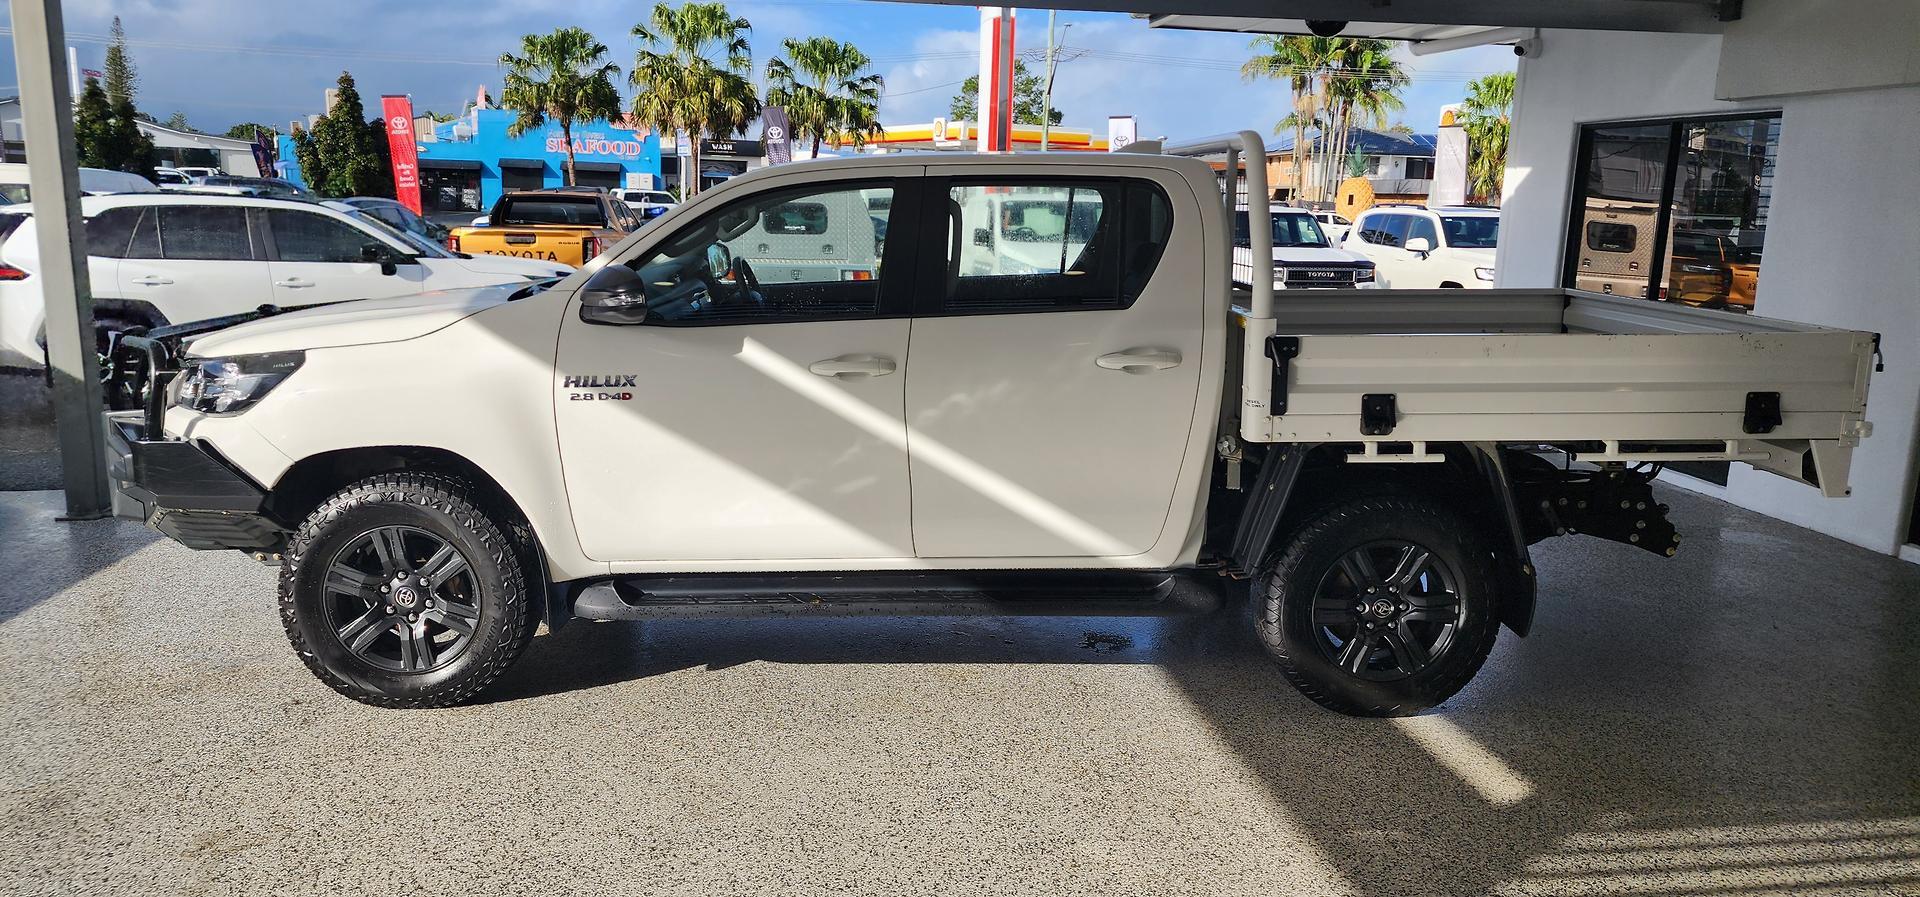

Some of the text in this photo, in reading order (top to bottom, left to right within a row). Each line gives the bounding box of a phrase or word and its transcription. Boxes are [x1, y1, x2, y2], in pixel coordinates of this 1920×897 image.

[546, 138, 641, 156] SEAFOOD
[711, 143, 733, 151] WASH
[563, 374, 638, 388] HILUX
[570, 392, 595, 401] 2.8
